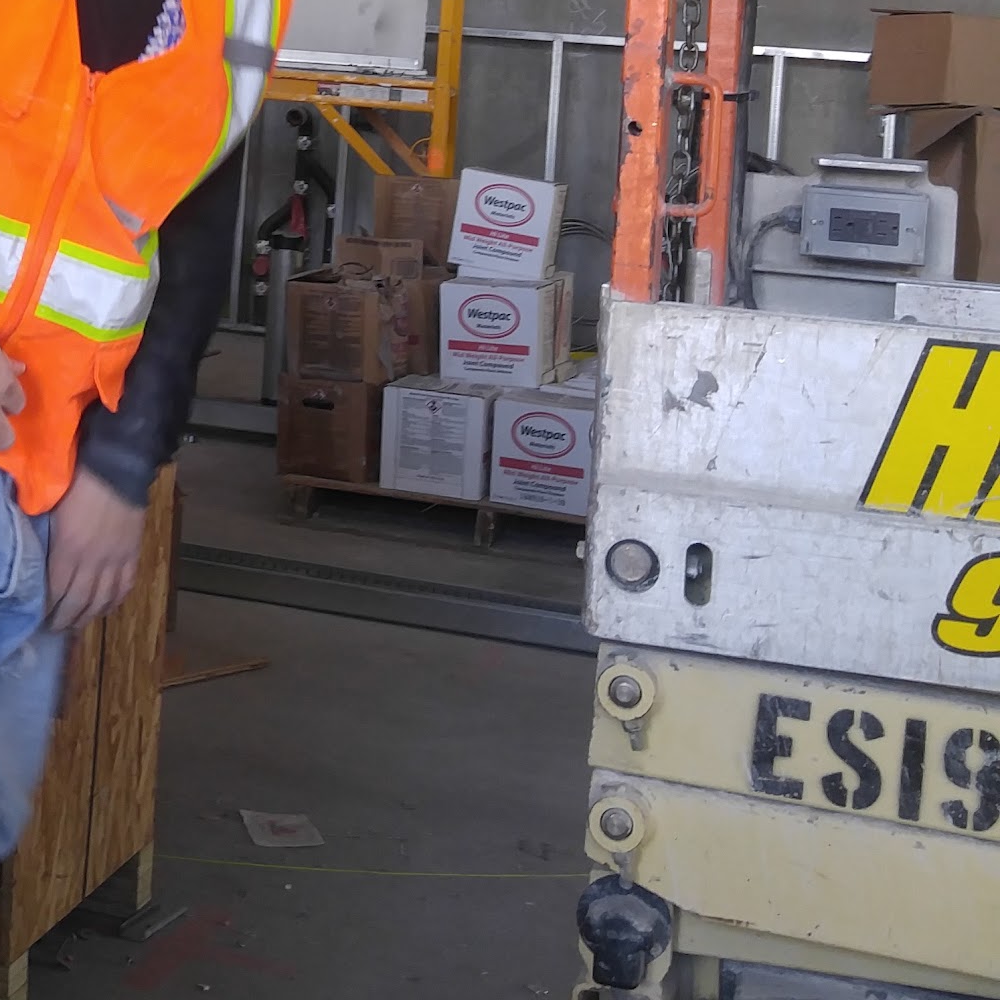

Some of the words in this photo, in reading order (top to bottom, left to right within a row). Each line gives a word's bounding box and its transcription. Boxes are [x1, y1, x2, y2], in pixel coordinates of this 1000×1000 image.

[484, 195, 527, 213] Westpac
[467, 307, 512, 323] Westpac
[520, 424, 567, 442] Westpac
